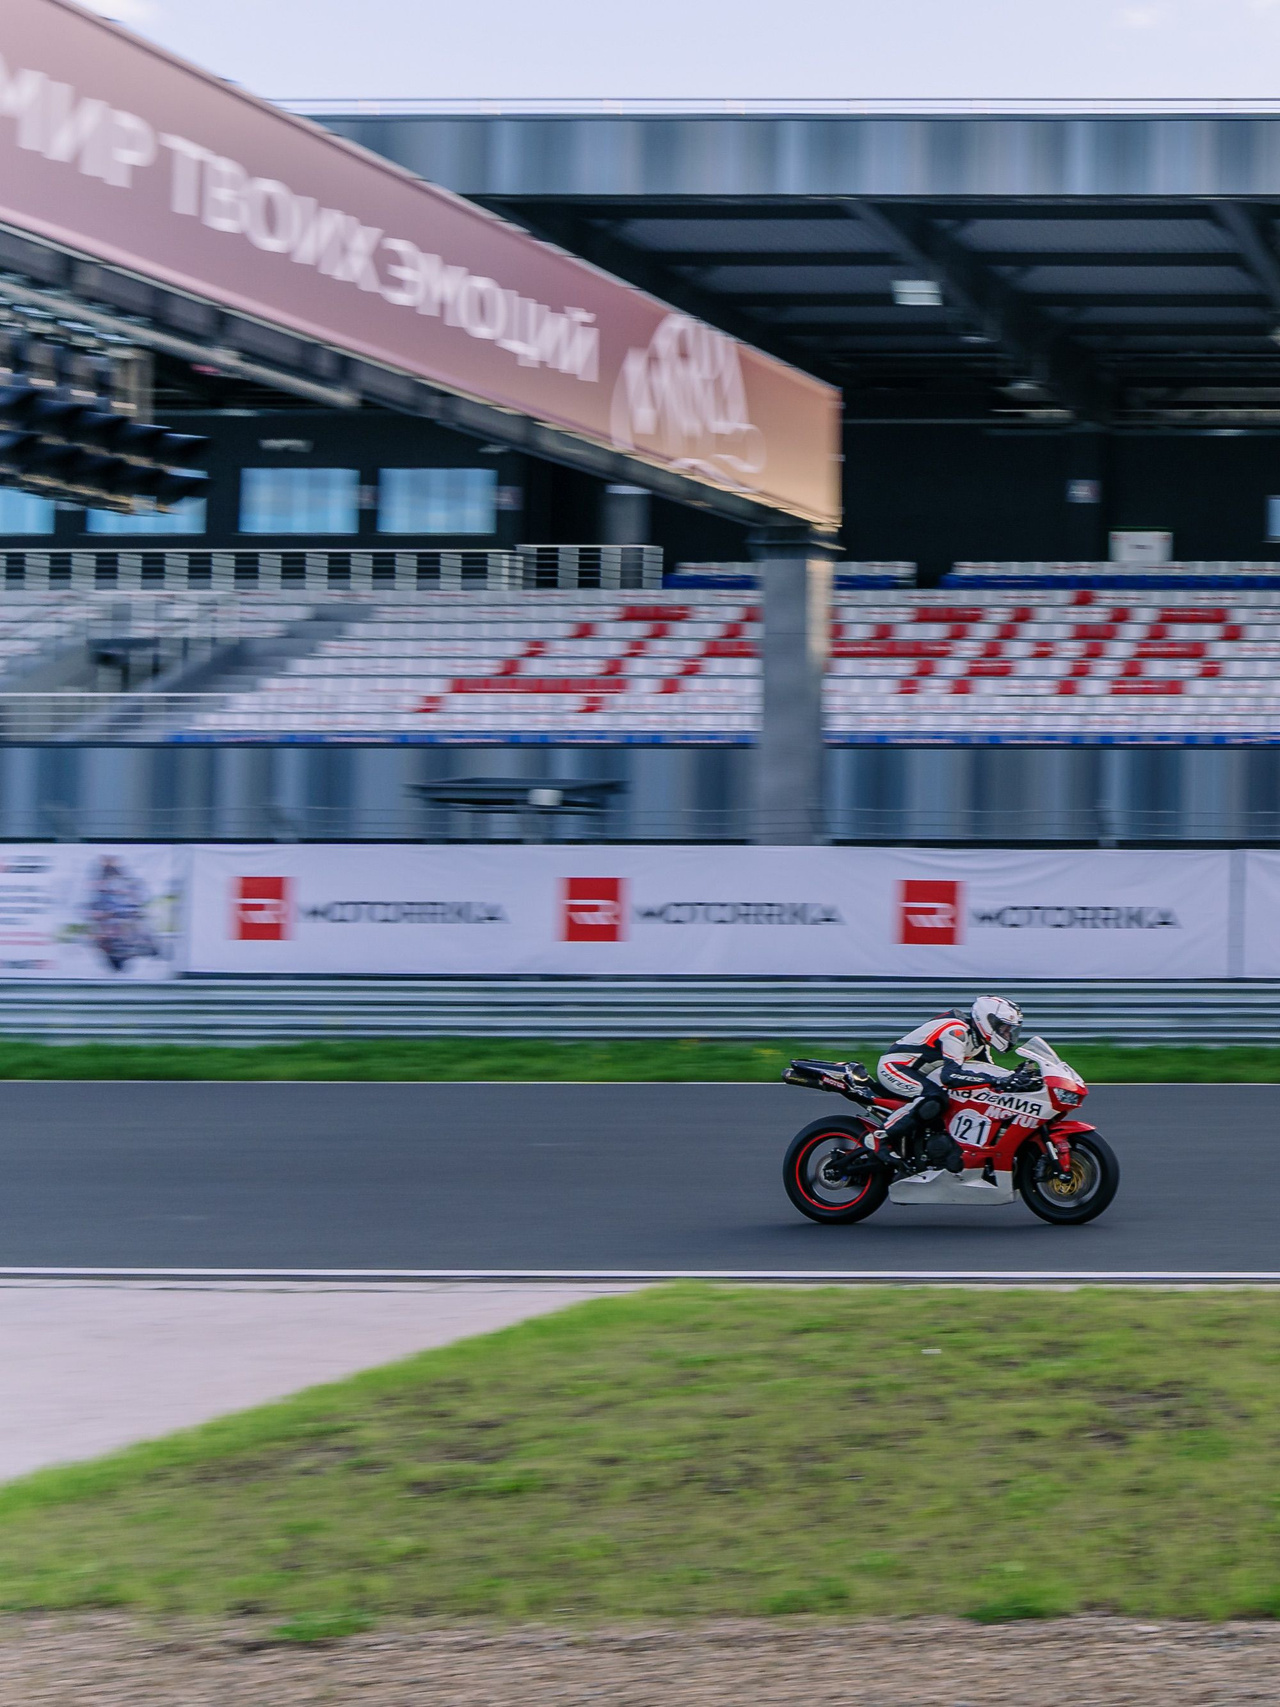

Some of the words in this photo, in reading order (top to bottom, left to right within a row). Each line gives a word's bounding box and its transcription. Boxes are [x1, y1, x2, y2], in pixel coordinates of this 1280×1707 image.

[156, 131, 384, 293] ТВОИХ
[380, 236, 600, 383] ЭМОЦИЙ
[968, 906, 1182, 928] MOTORRIKA
[954, 1115, 986, 1145] 121
[984, 1105, 1040, 1129] MOTUL
